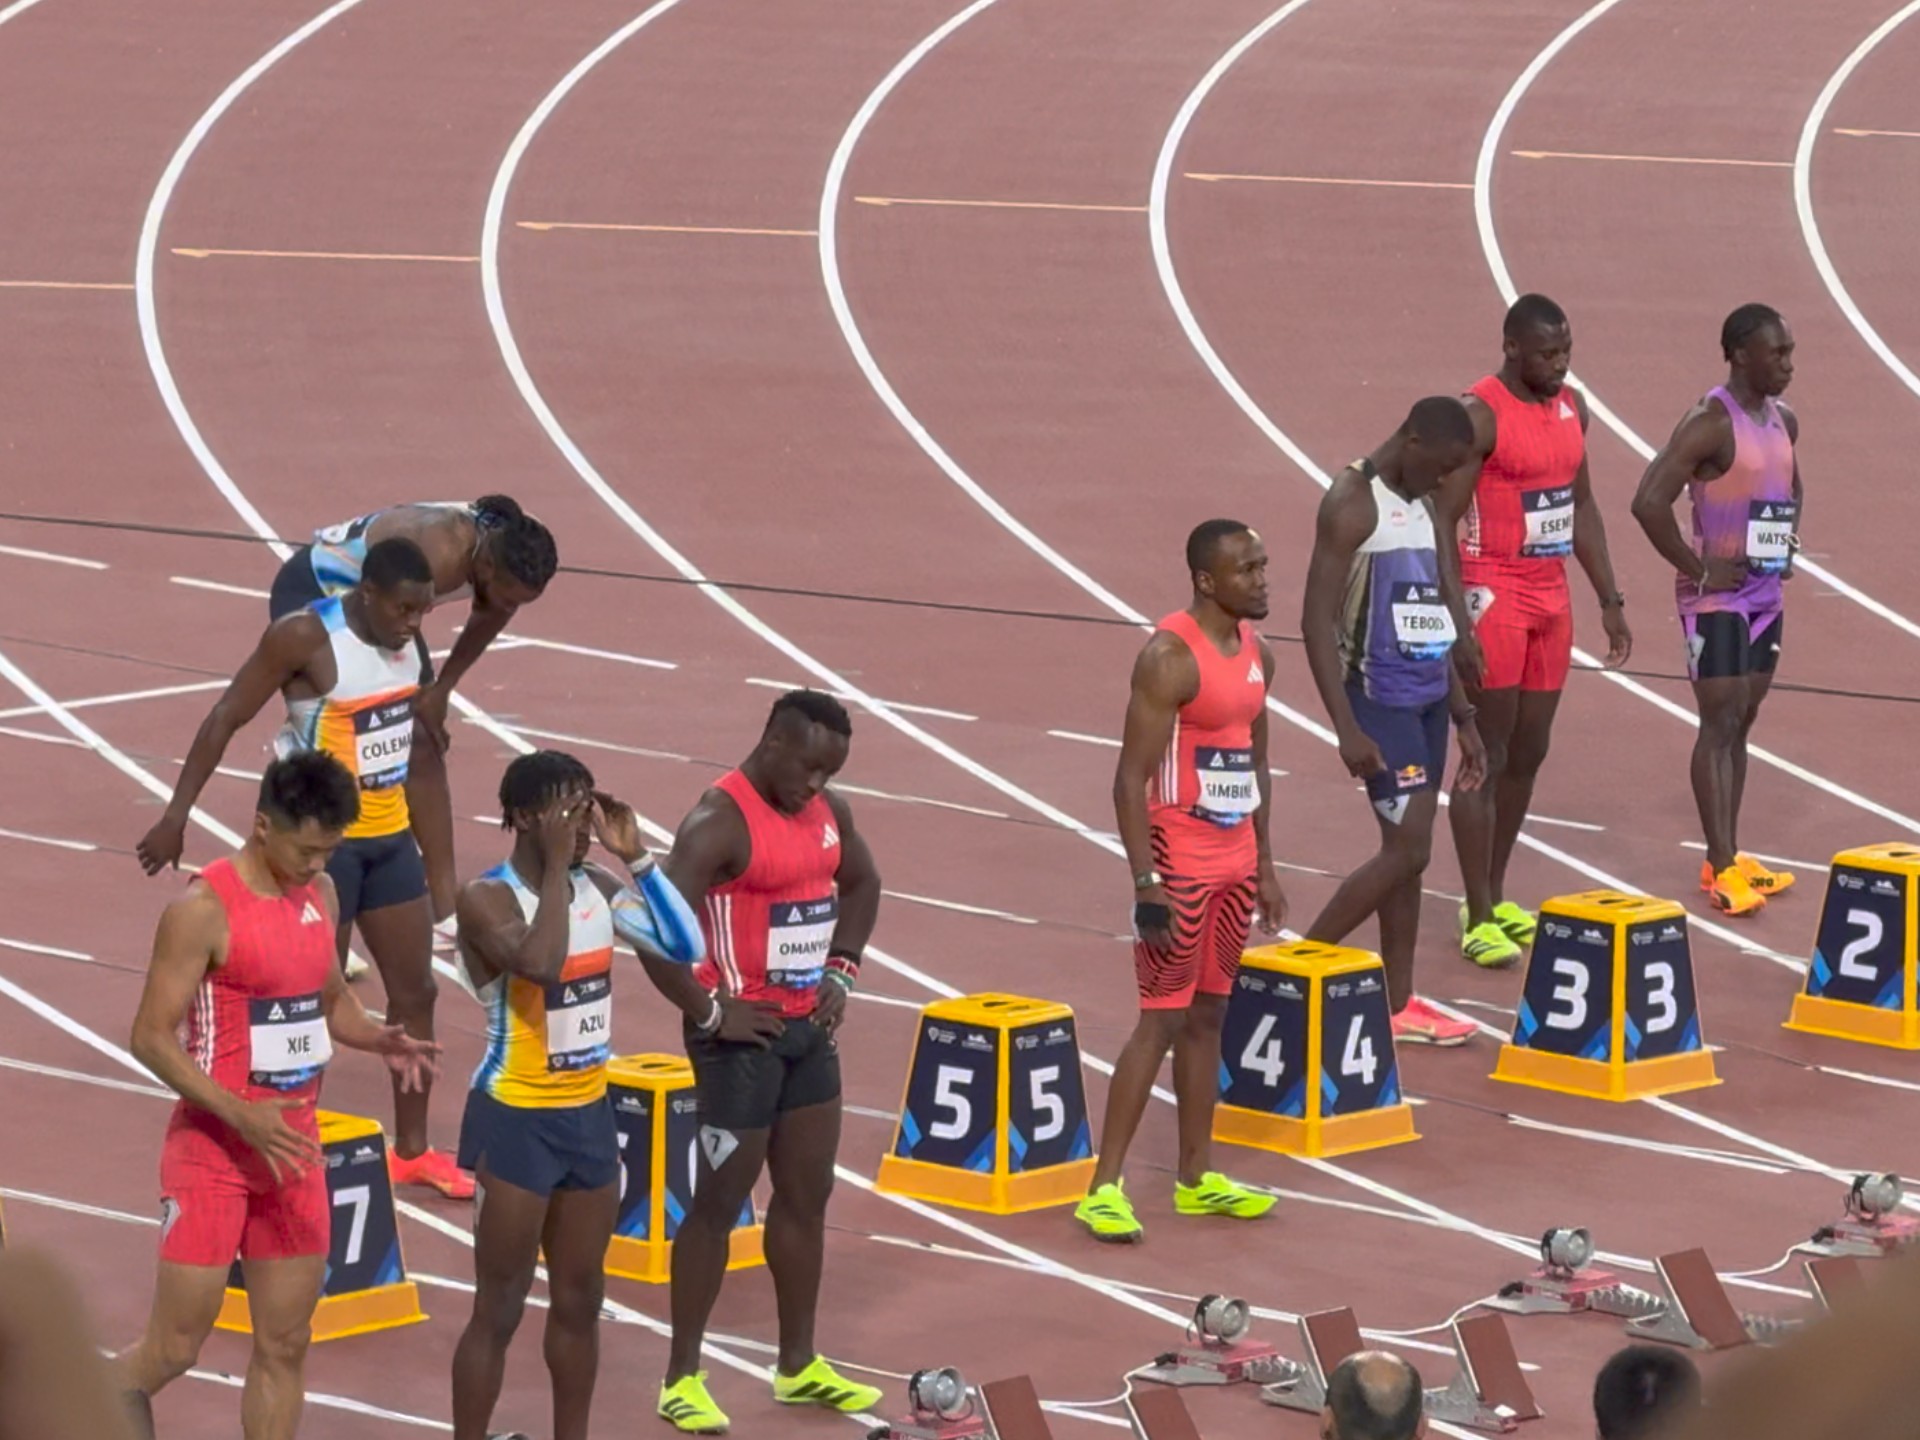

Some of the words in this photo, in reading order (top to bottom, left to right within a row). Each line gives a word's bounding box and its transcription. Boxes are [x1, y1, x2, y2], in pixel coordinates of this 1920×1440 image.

[1839, 909, 1883, 981] 2
[578, 1014, 605, 1034] AZU
[1545, 958, 1590, 1030] 3
[1644, 961, 1677, 1032] 3
[287, 1035, 311, 1054] XIE
[1240, 1014, 1285, 1086] 4
[1341, 1014, 1377, 1085] 4
[929, 1064, 974, 1140] 5
[1029, 1065, 1065, 1142] 5
[333, 1185, 370, 1265] 7
